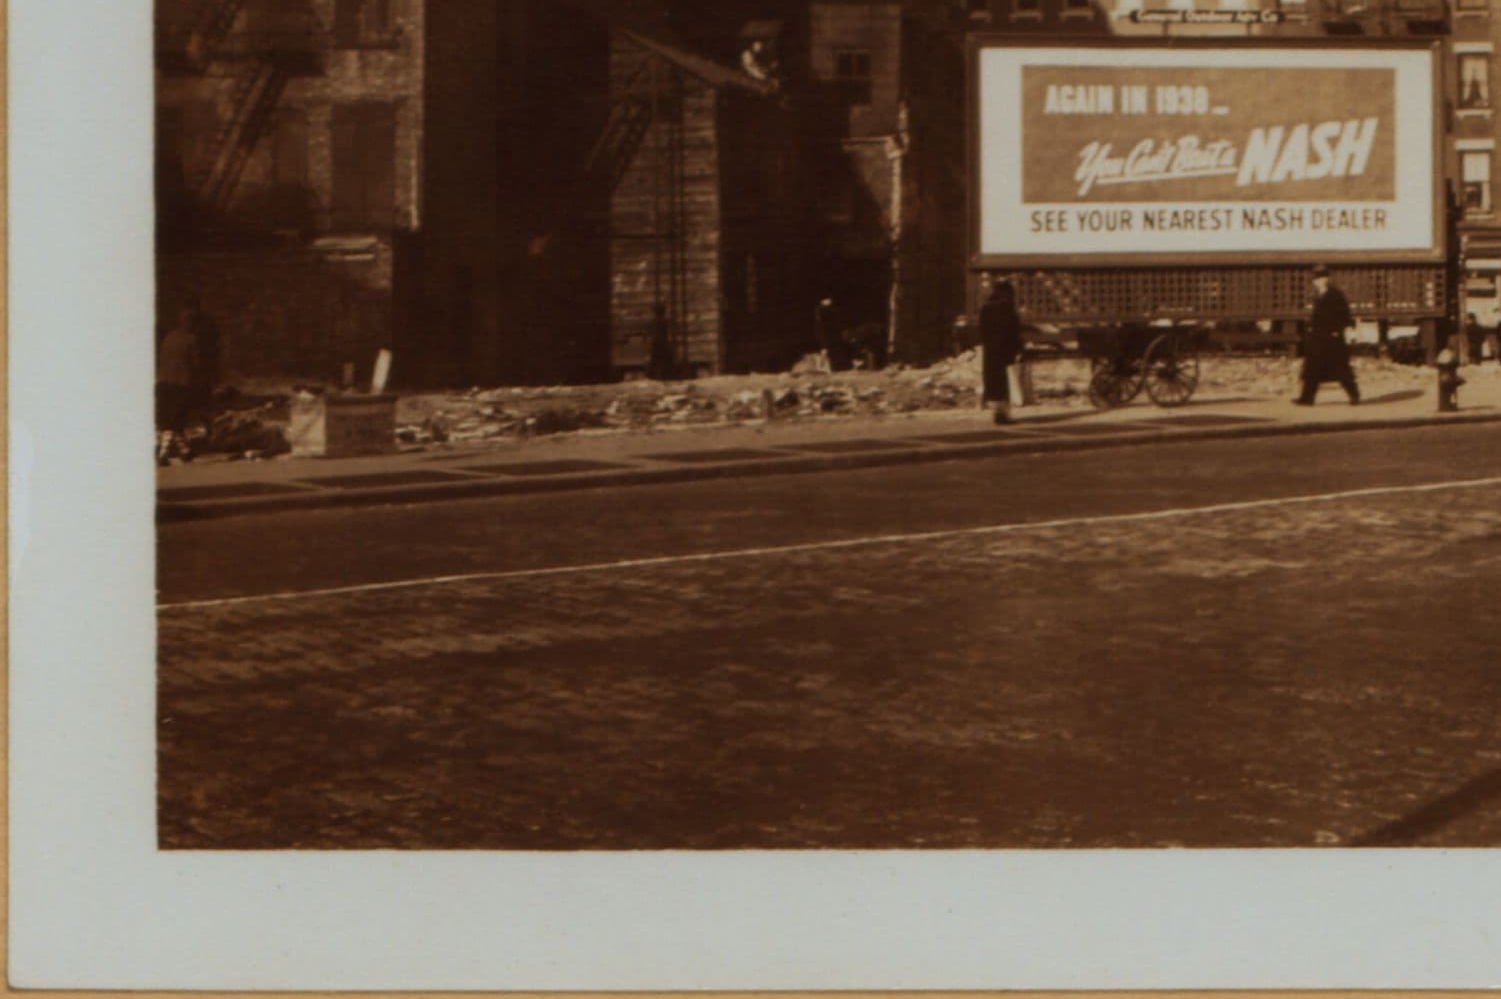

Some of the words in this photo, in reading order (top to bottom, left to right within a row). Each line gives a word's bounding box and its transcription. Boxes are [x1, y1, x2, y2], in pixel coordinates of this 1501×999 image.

[1044, 84, 1114, 114] AGAIN
[1121, 84, 1147, 114] IN
[1074, 140, 1125, 196] You
[1236, 117, 1379, 187] NASH
[1030, 210, 1068, 233] SEE
[1077, 209, 1132, 232] YOUR
[1143, 208, 1233, 231] NEAREST
[1242, 208, 1302, 231] NASH
[1311, 208, 1387, 230] DEALER
